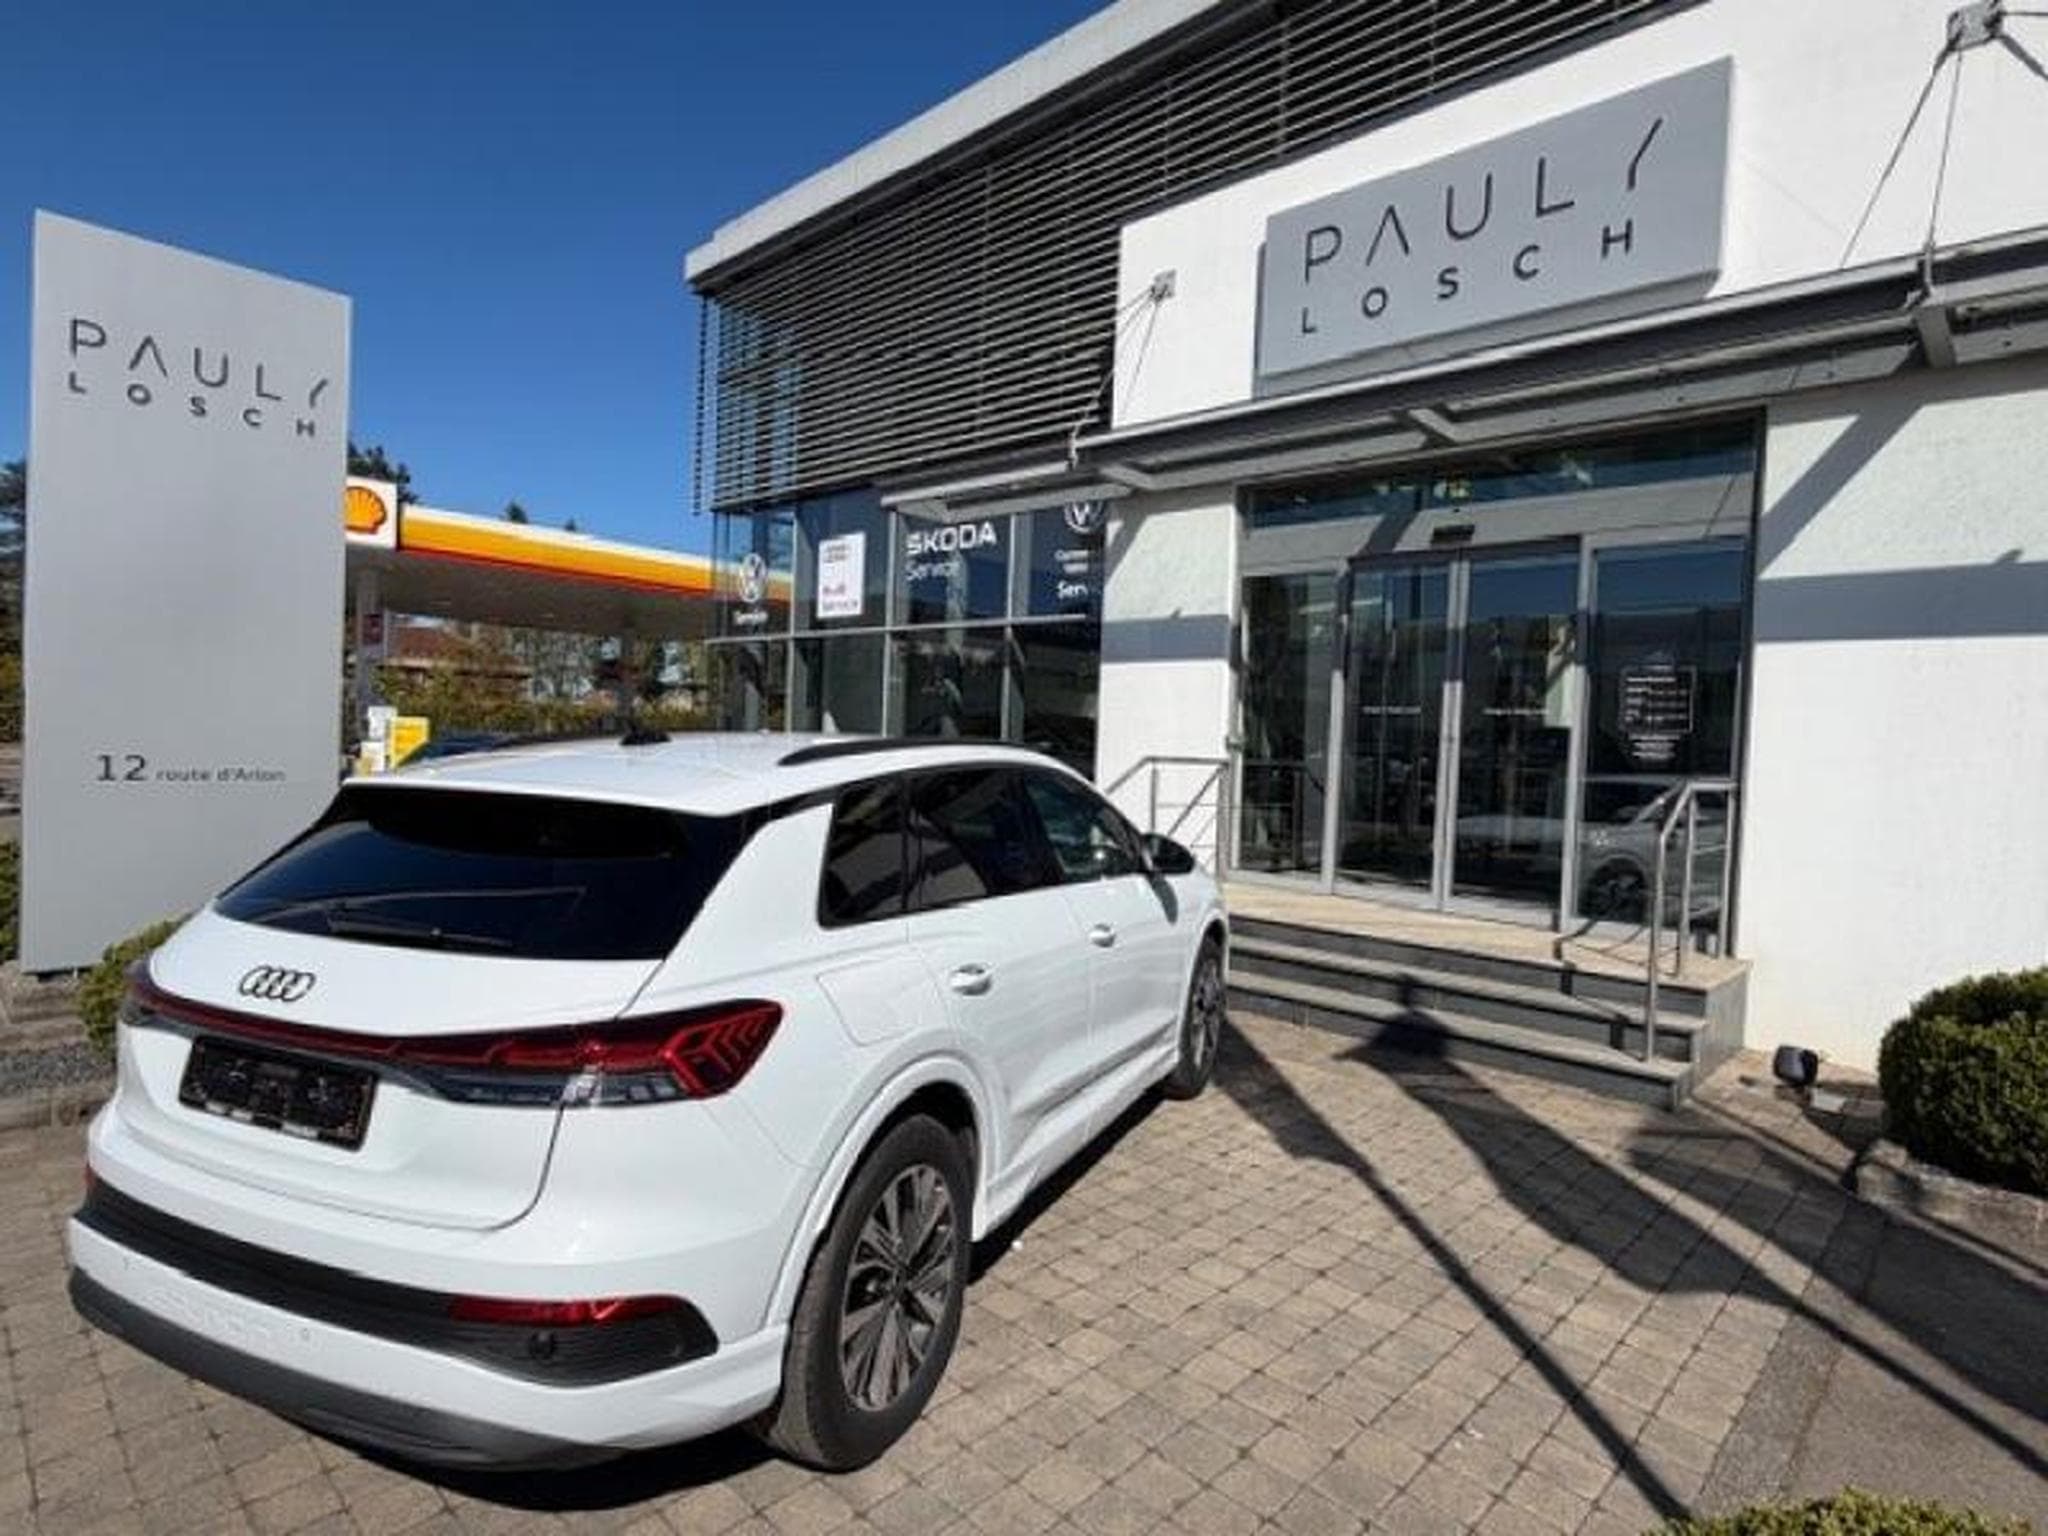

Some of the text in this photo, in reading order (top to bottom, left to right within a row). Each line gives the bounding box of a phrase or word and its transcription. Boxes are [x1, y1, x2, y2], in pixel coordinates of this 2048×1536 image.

[1300, 217, 1634, 337] LOSCH
[67, 370, 316, 439] LOSCH
[96, 754, 286, 782] 12 route d'Arlon
